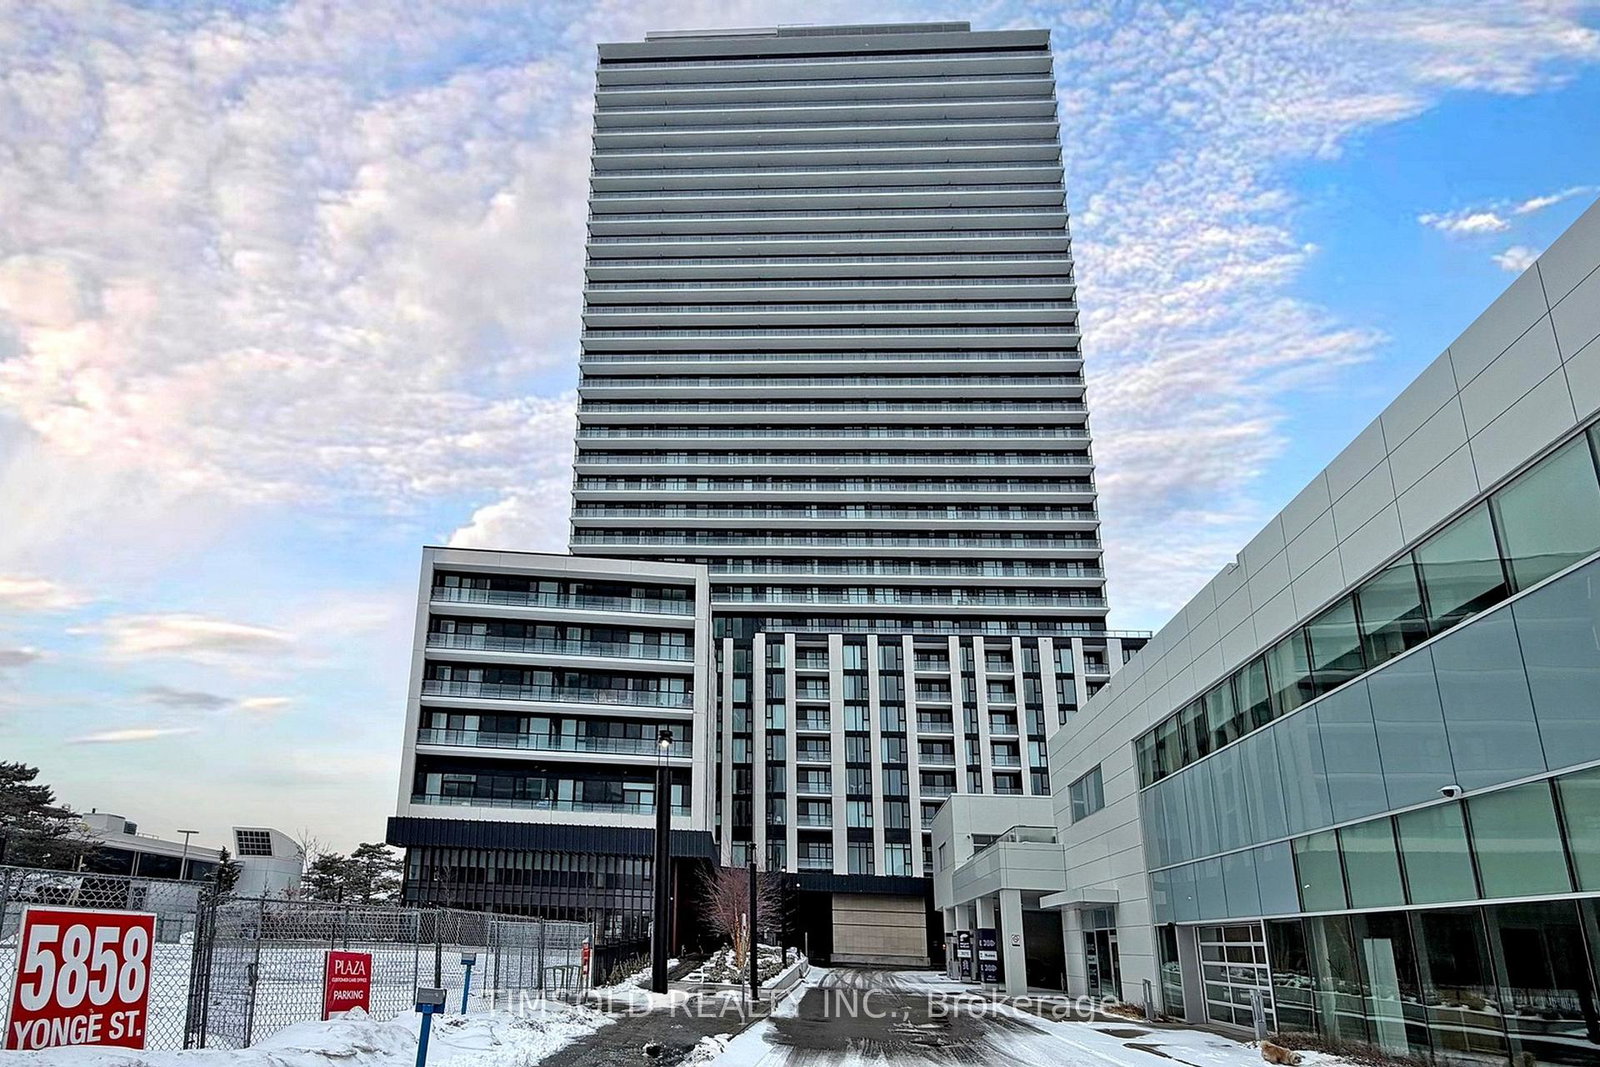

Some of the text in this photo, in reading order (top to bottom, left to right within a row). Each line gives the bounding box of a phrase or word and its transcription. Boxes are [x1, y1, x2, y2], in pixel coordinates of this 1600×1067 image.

[20, 924, 149, 1011] 5858
[335, 960, 365, 975] PLAZA
[334, 990, 363, 1000] PARKING
[14, 1010, 142, 1050] YONGE ST.
